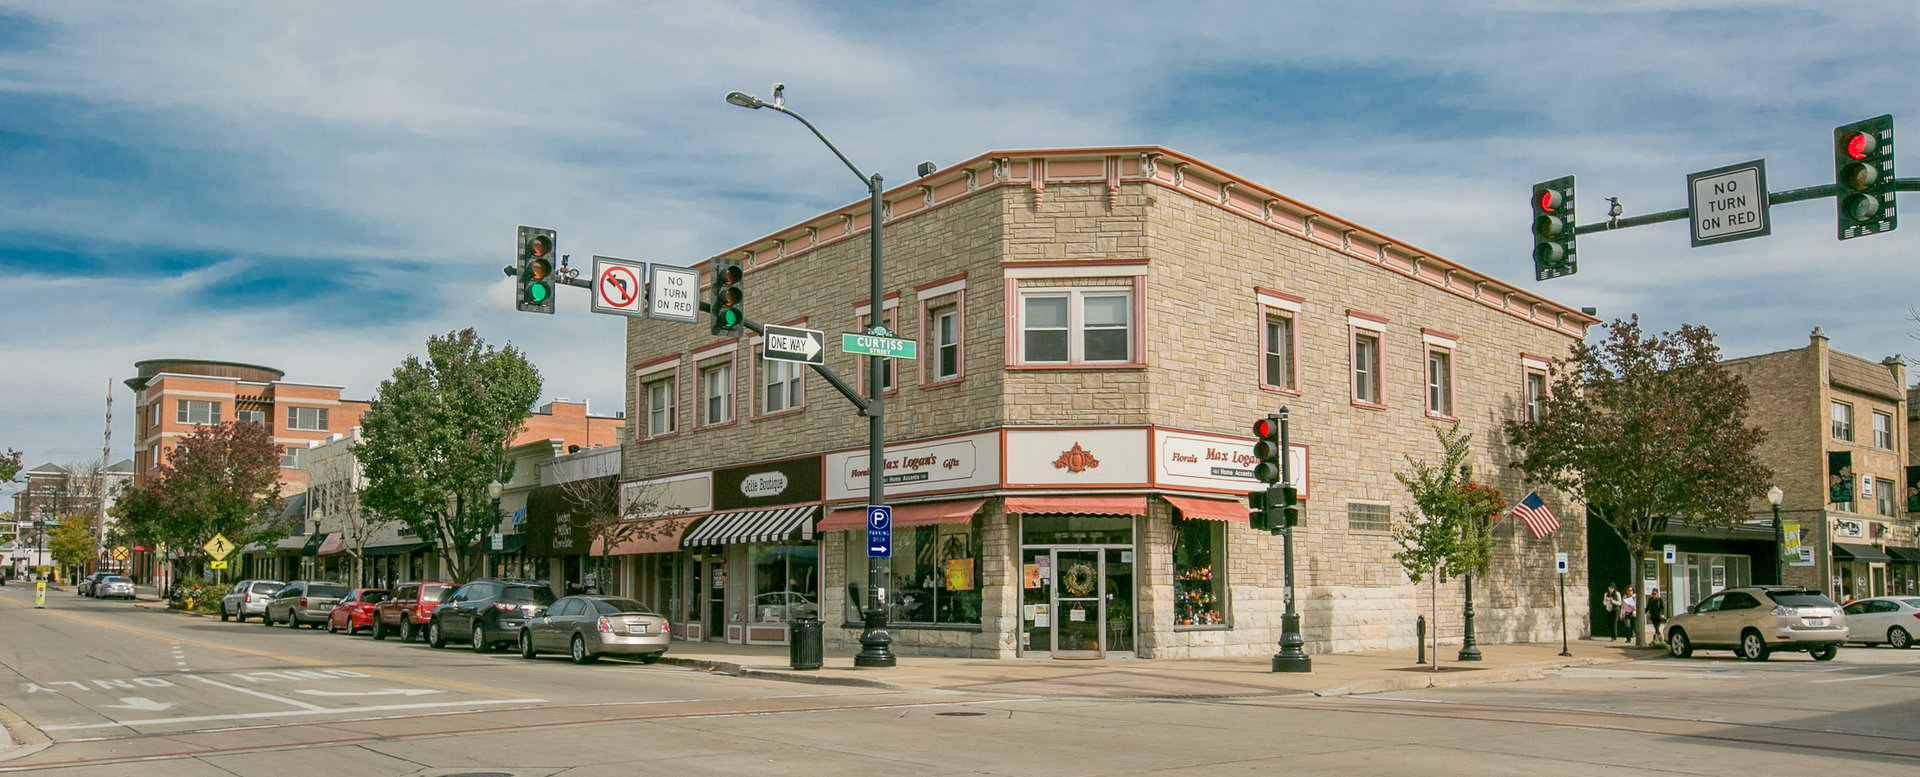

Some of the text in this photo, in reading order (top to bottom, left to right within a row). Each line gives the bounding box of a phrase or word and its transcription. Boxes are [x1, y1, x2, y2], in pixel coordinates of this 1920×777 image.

[1714, 180, 1737, 195] NO
[1708, 195, 1746, 213] TURN
[1702, 211, 1755, 230] ON RED
[668, 276, 683, 286] NO
[663, 288, 688, 299] TURN
[657, 300, 692, 312] ON RED
[770, 336, 807, 352] ONE WAY
[857, 336, 904, 351] CURTISS
[869, 347, 891, 356] STREET
[902, 453, 937, 471] Logan's
[943, 458, 960, 470] Gifts
[1172, 452, 1198, 464] Florals
[1205, 447, 1229, 462] Max
[1220, 468, 1253, 478] Home Accents
[745, 477, 783, 493] Jolie Boutique
[874, 512, 885, 525] P
[26, 677, 174, 693] ONLY
